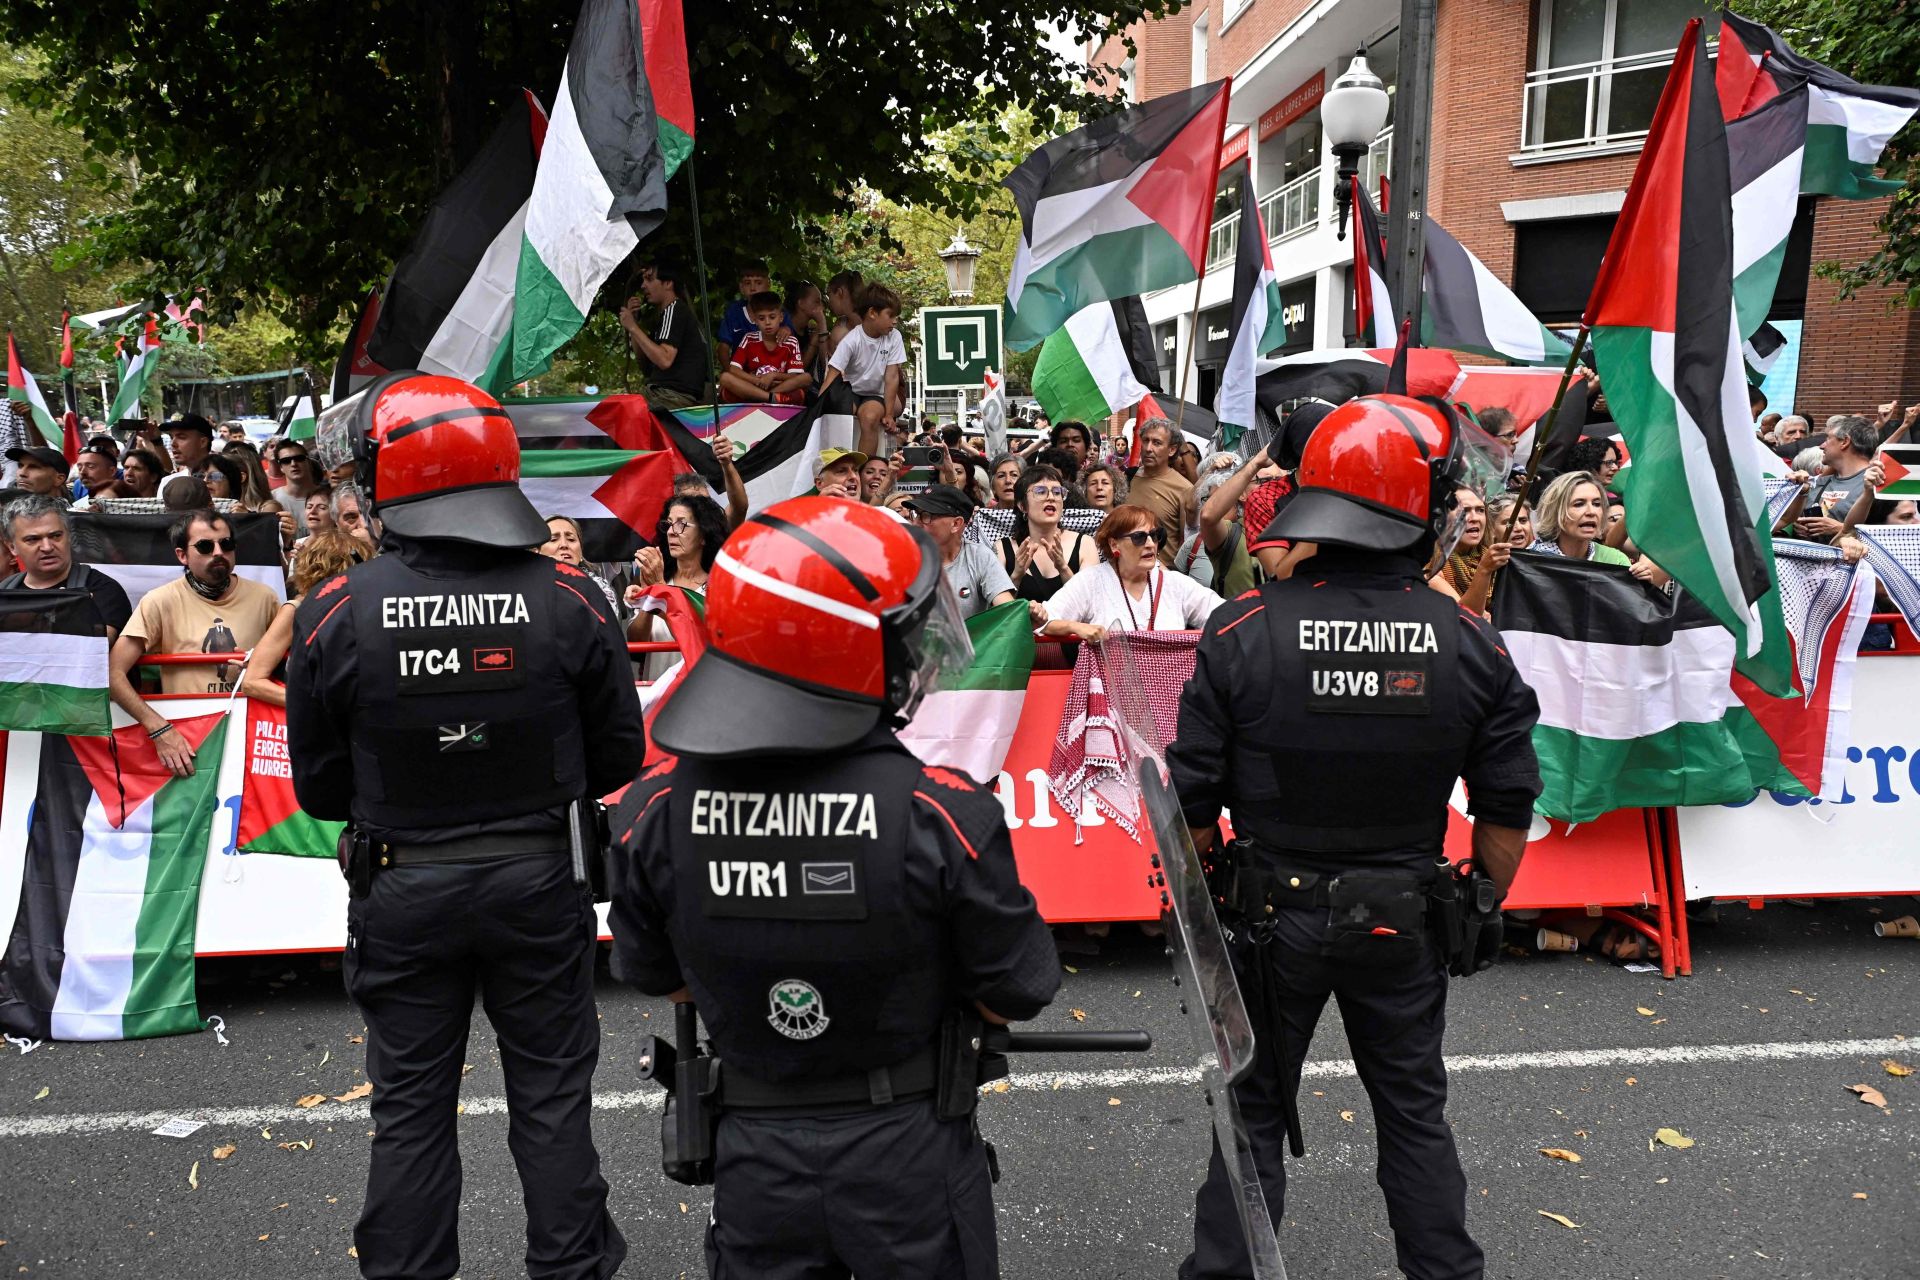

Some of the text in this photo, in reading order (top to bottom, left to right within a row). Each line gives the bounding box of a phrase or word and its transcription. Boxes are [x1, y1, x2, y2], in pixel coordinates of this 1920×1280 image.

[1228, 135, 1247, 156] PARQUE
[382, 593, 531, 628] ERTZAINTZA
[1299, 620, 1439, 653] ERTZAINTZA
[1312, 670, 1379, 697] U3V8
[691, 790, 878, 840] ERTZAINTZA
[708, 861, 788, 897] U7R1
[769, 1017, 828, 1039] ERTZAINTZA
